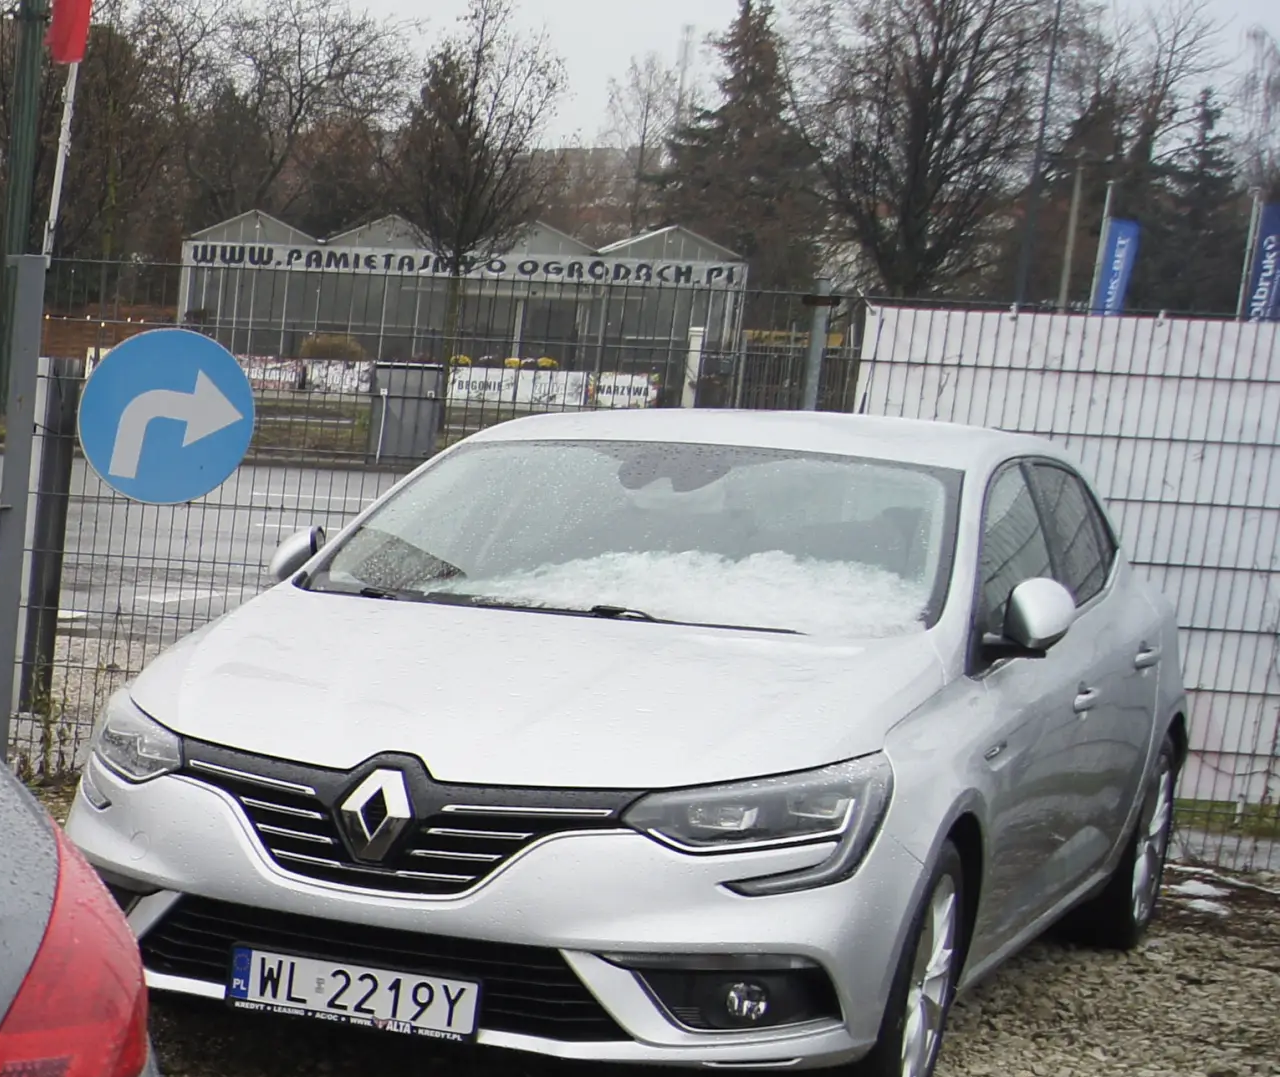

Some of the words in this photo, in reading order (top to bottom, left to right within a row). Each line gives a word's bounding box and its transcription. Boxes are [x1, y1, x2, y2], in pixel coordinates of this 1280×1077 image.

[1248, 251, 1275, 322] olbruk
[596, 384, 649, 397] WARZYWA
[232, 979, 247, 991] PL
[258, 956, 308, 1005] WL
[326, 968, 467, 1028] 2219Y
[234, 1001, 265, 1011] KREDYT
[273, 1006, 305, 1016] LEASING
